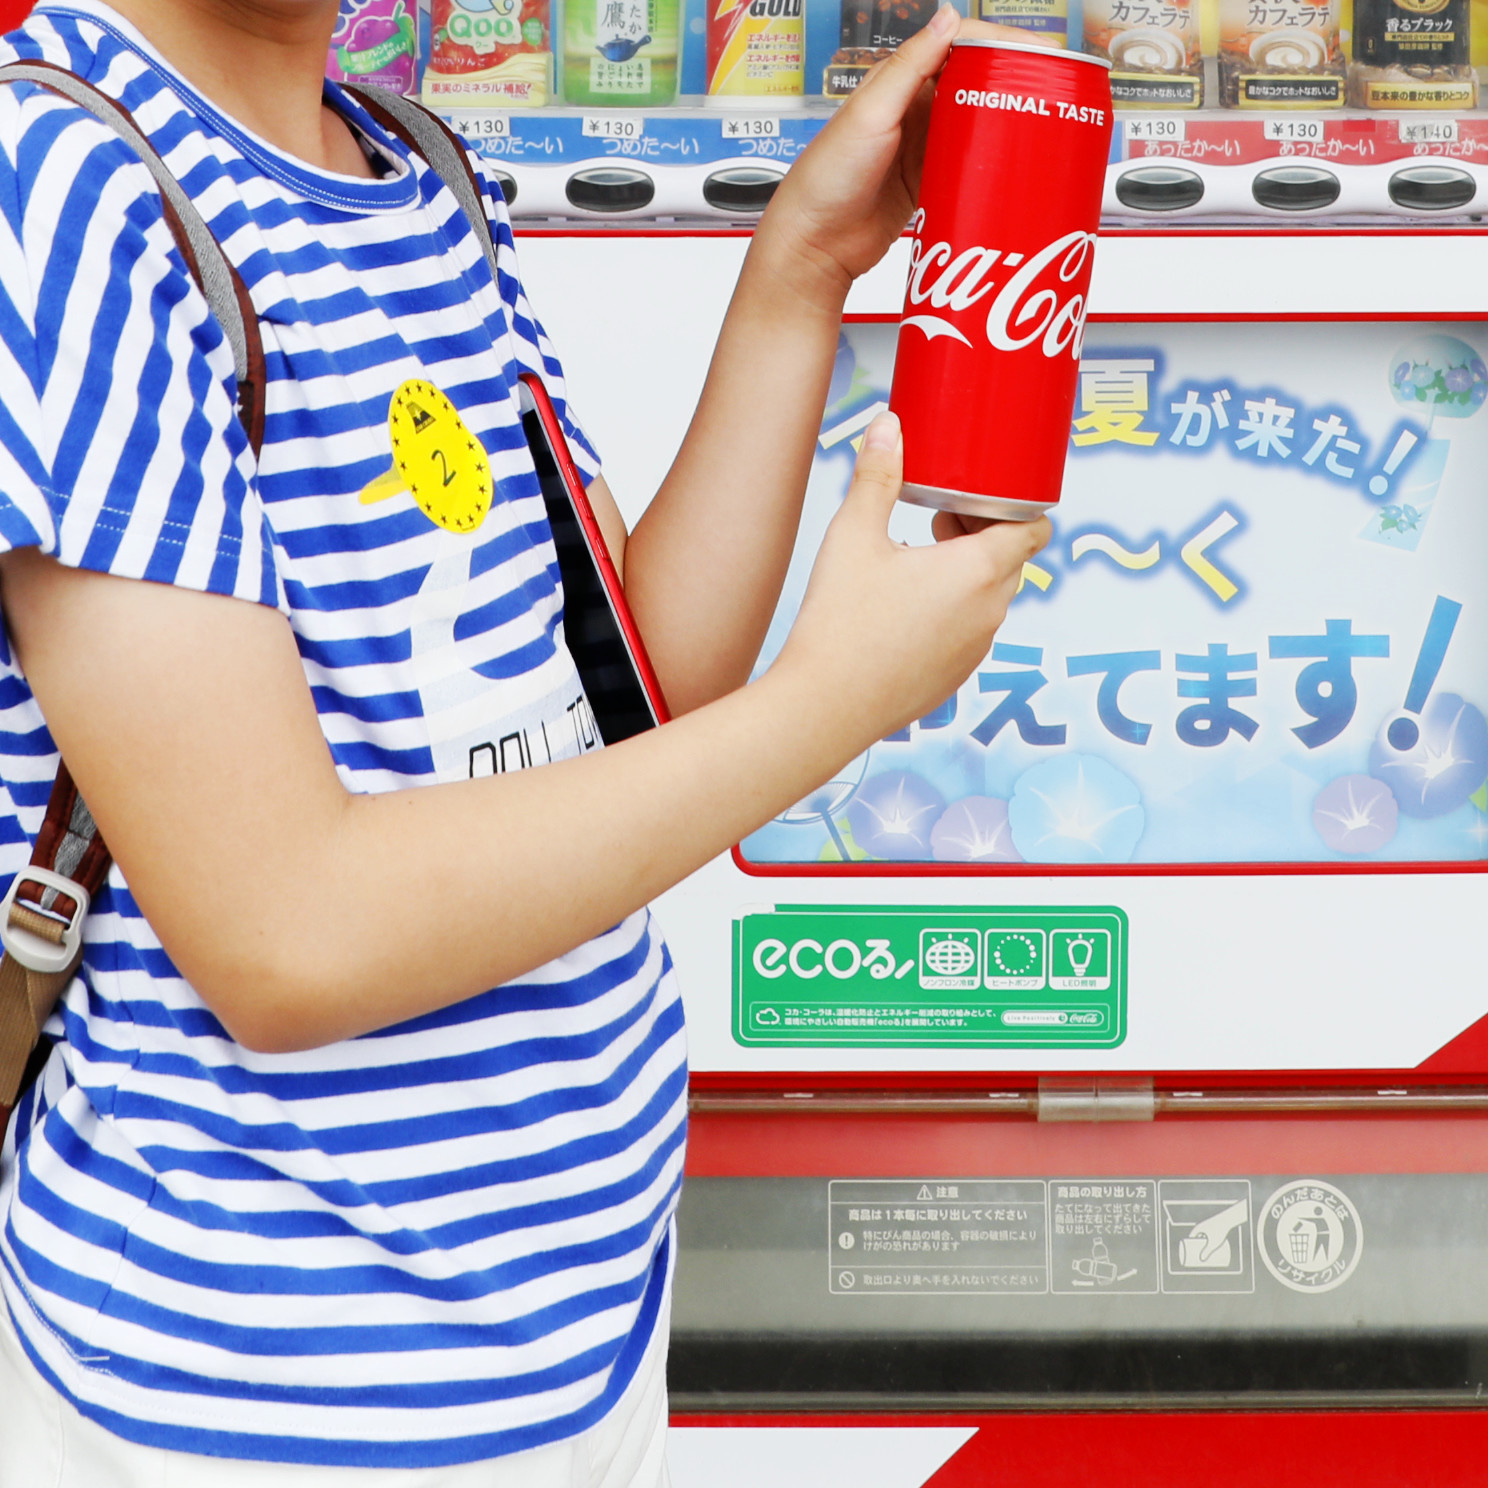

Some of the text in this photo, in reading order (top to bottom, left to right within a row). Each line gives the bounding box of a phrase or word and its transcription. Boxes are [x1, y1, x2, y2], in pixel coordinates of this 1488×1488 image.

[1111, 2, 1191, 29] カフェラテ
[1248, 3, 1330, 29] カフェラテ
[449, 13, 514, 39] Qoo
[1386, 17, 1453, 33] 香るブラック
[873, 34, 903, 45] コーヒー
[1371, 88, 1470, 103] 豆本来の豊かな香りとコク
[955, 89, 1105, 126] ORIGINAL TASTE
[991, 978, 1038, 988] ヒートポンプ
[1061, 978, 1097, 988] LED照明
[935, 1186, 960, 1199] 注意
[1057, 1186, 1148, 1199] 商品の取り出し方
[1054, 1202, 1152, 1214] たてになって出てきた
[1270, 1186, 1351, 1222] のんだあとは
[1054, 1223, 1143, 1235] 取り出してください
[1276, 1258, 1346, 1286] リサイクル
